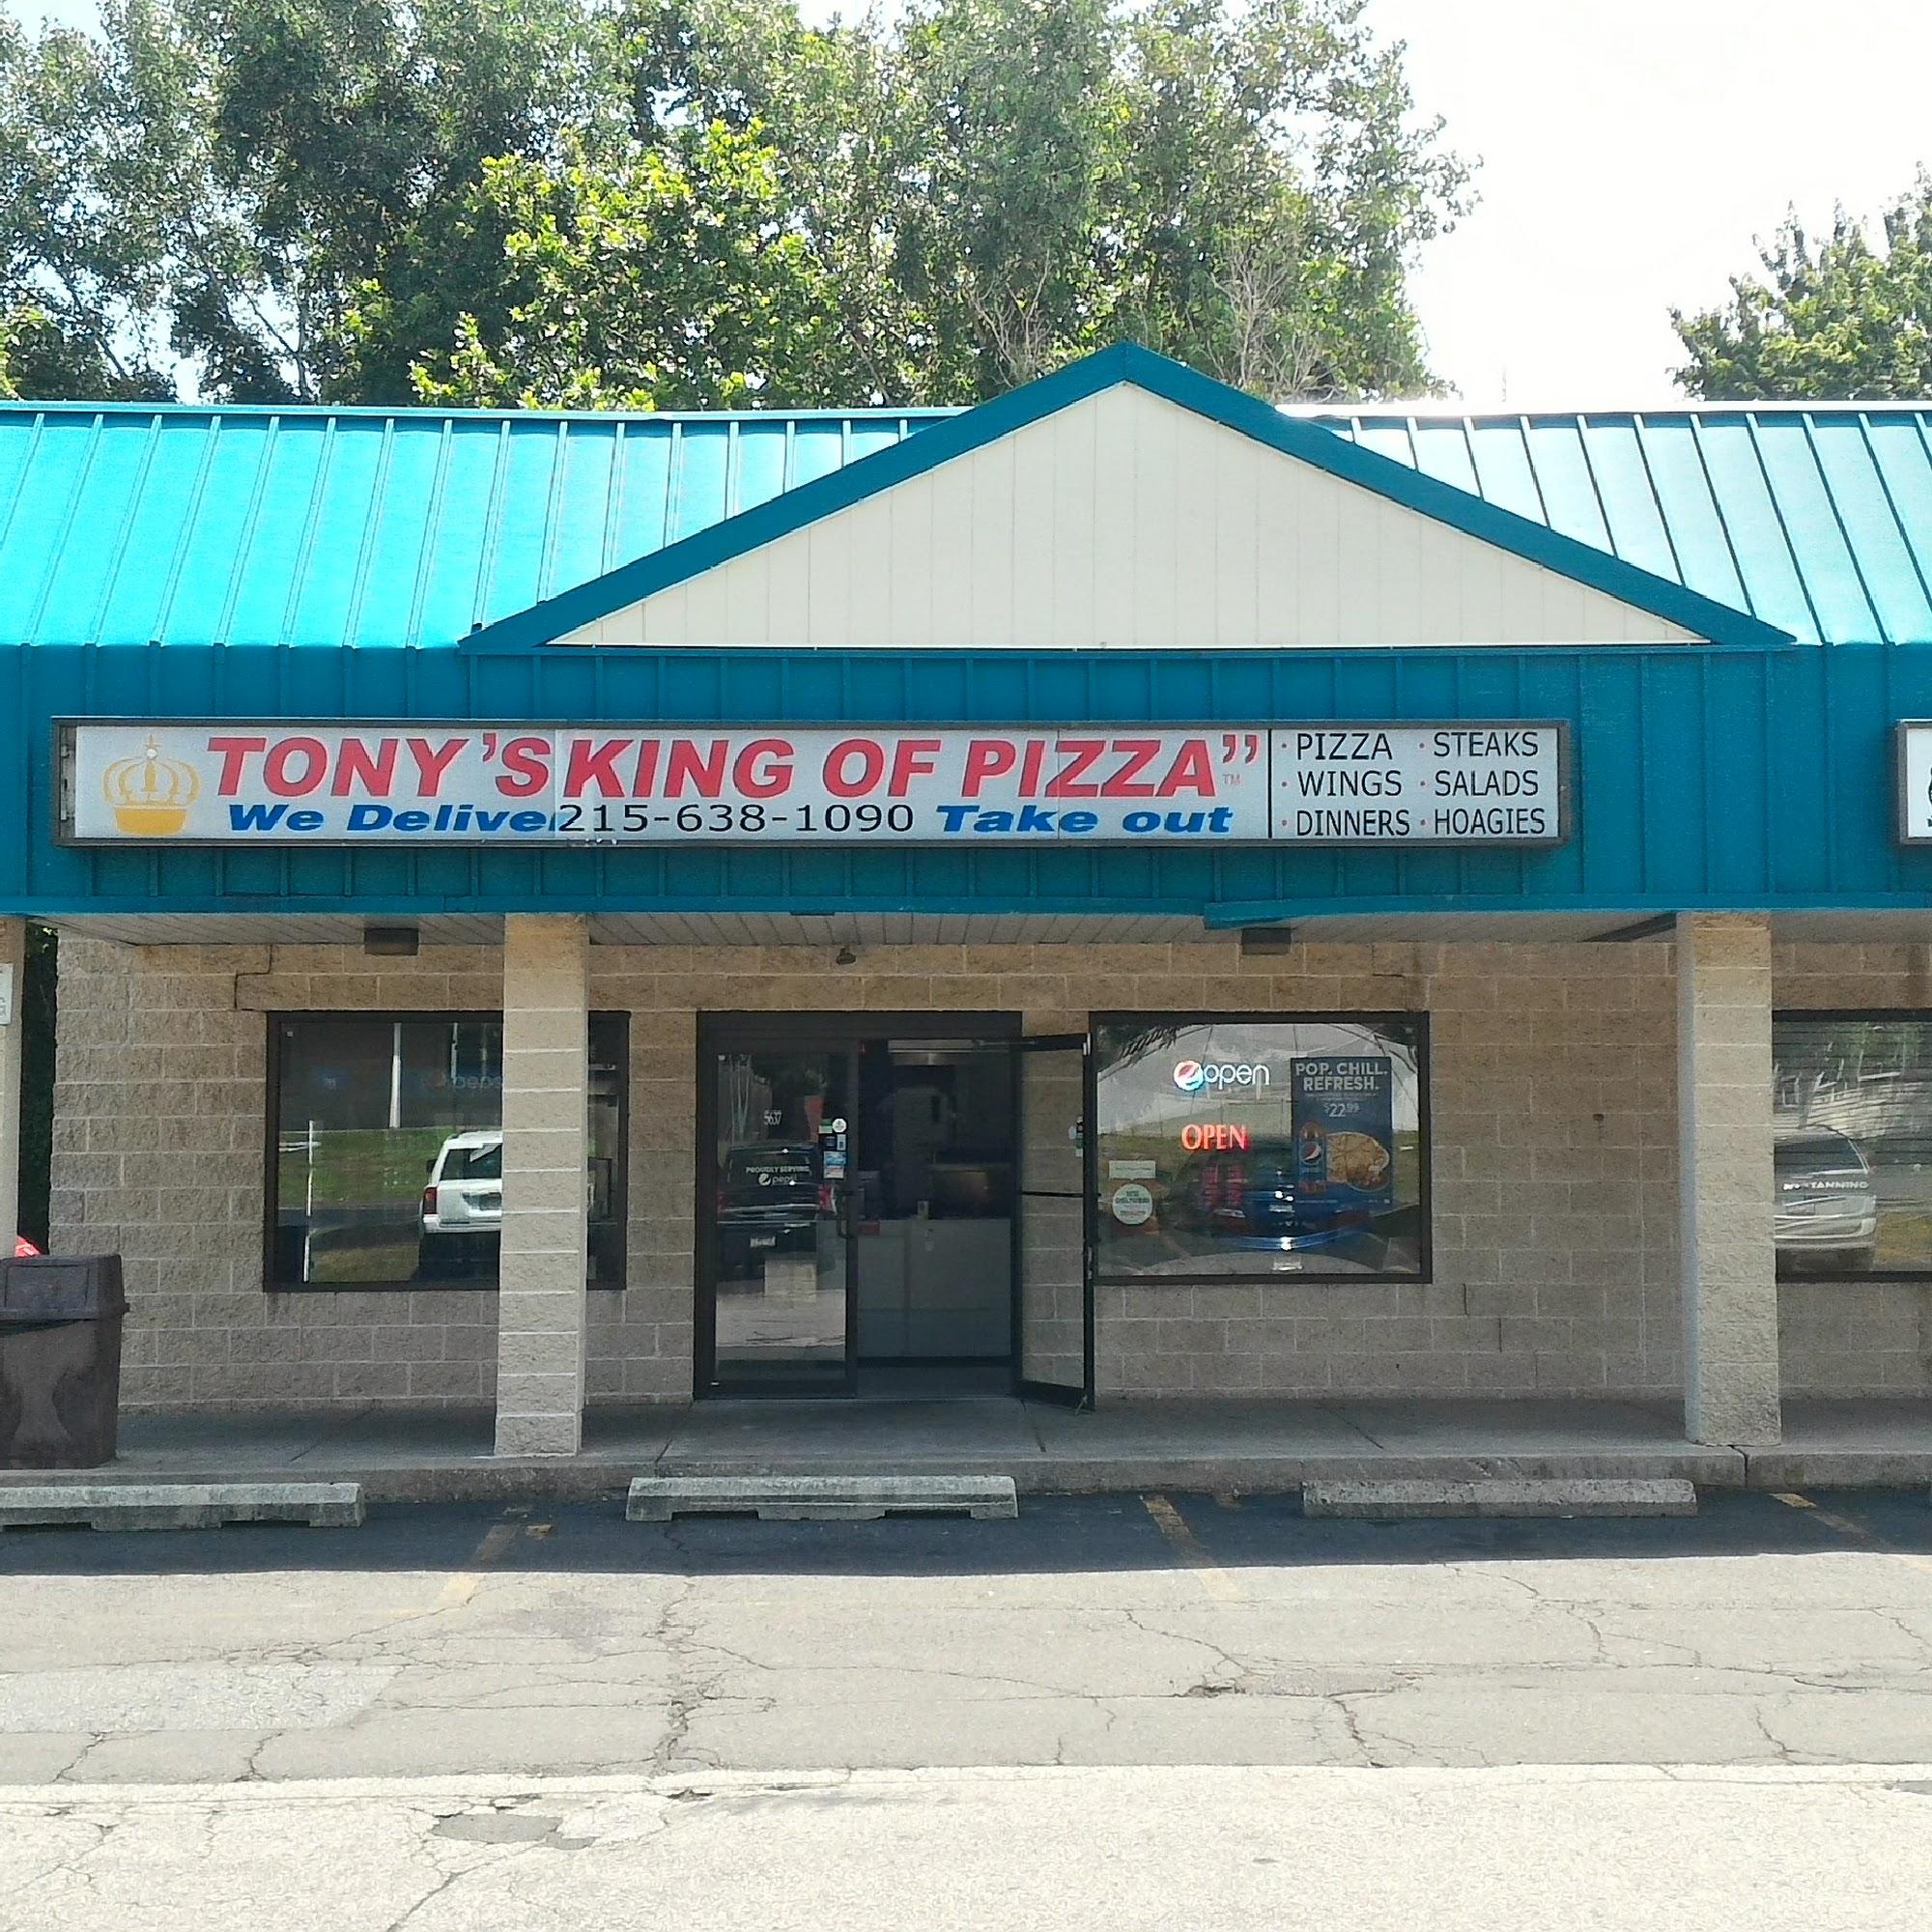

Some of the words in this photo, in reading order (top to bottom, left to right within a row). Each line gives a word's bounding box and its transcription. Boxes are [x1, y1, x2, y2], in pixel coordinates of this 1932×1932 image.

[1297, 733, 1393, 760] PIZZA
[1434, 731, 1539, 757] STEAKS
[208, 732, 551, 798] TONY'S
[563, 738, 794, 798] KING
[823, 738, 941, 798] OF
[1298, 770, 1402, 797] WINGS
[1435, 770, 1539, 797] SALADS
[229, 804, 325, 832] We
[558, 804, 913, 833] 215-638-1090
[937, 805, 1098, 833] Take
[1122, 807, 1234, 833] out
[1296, 809, 1410, 837] DINNERS
[1435, 808, 1546, 835] HOAGIES
[1204, 1065, 1270, 1091] open
[1295, 1063, 1333, 1075] POP.
[1303, 1076, 1380, 1092] REFRESH.
[1181, 1123, 1250, 1151] OPEN
